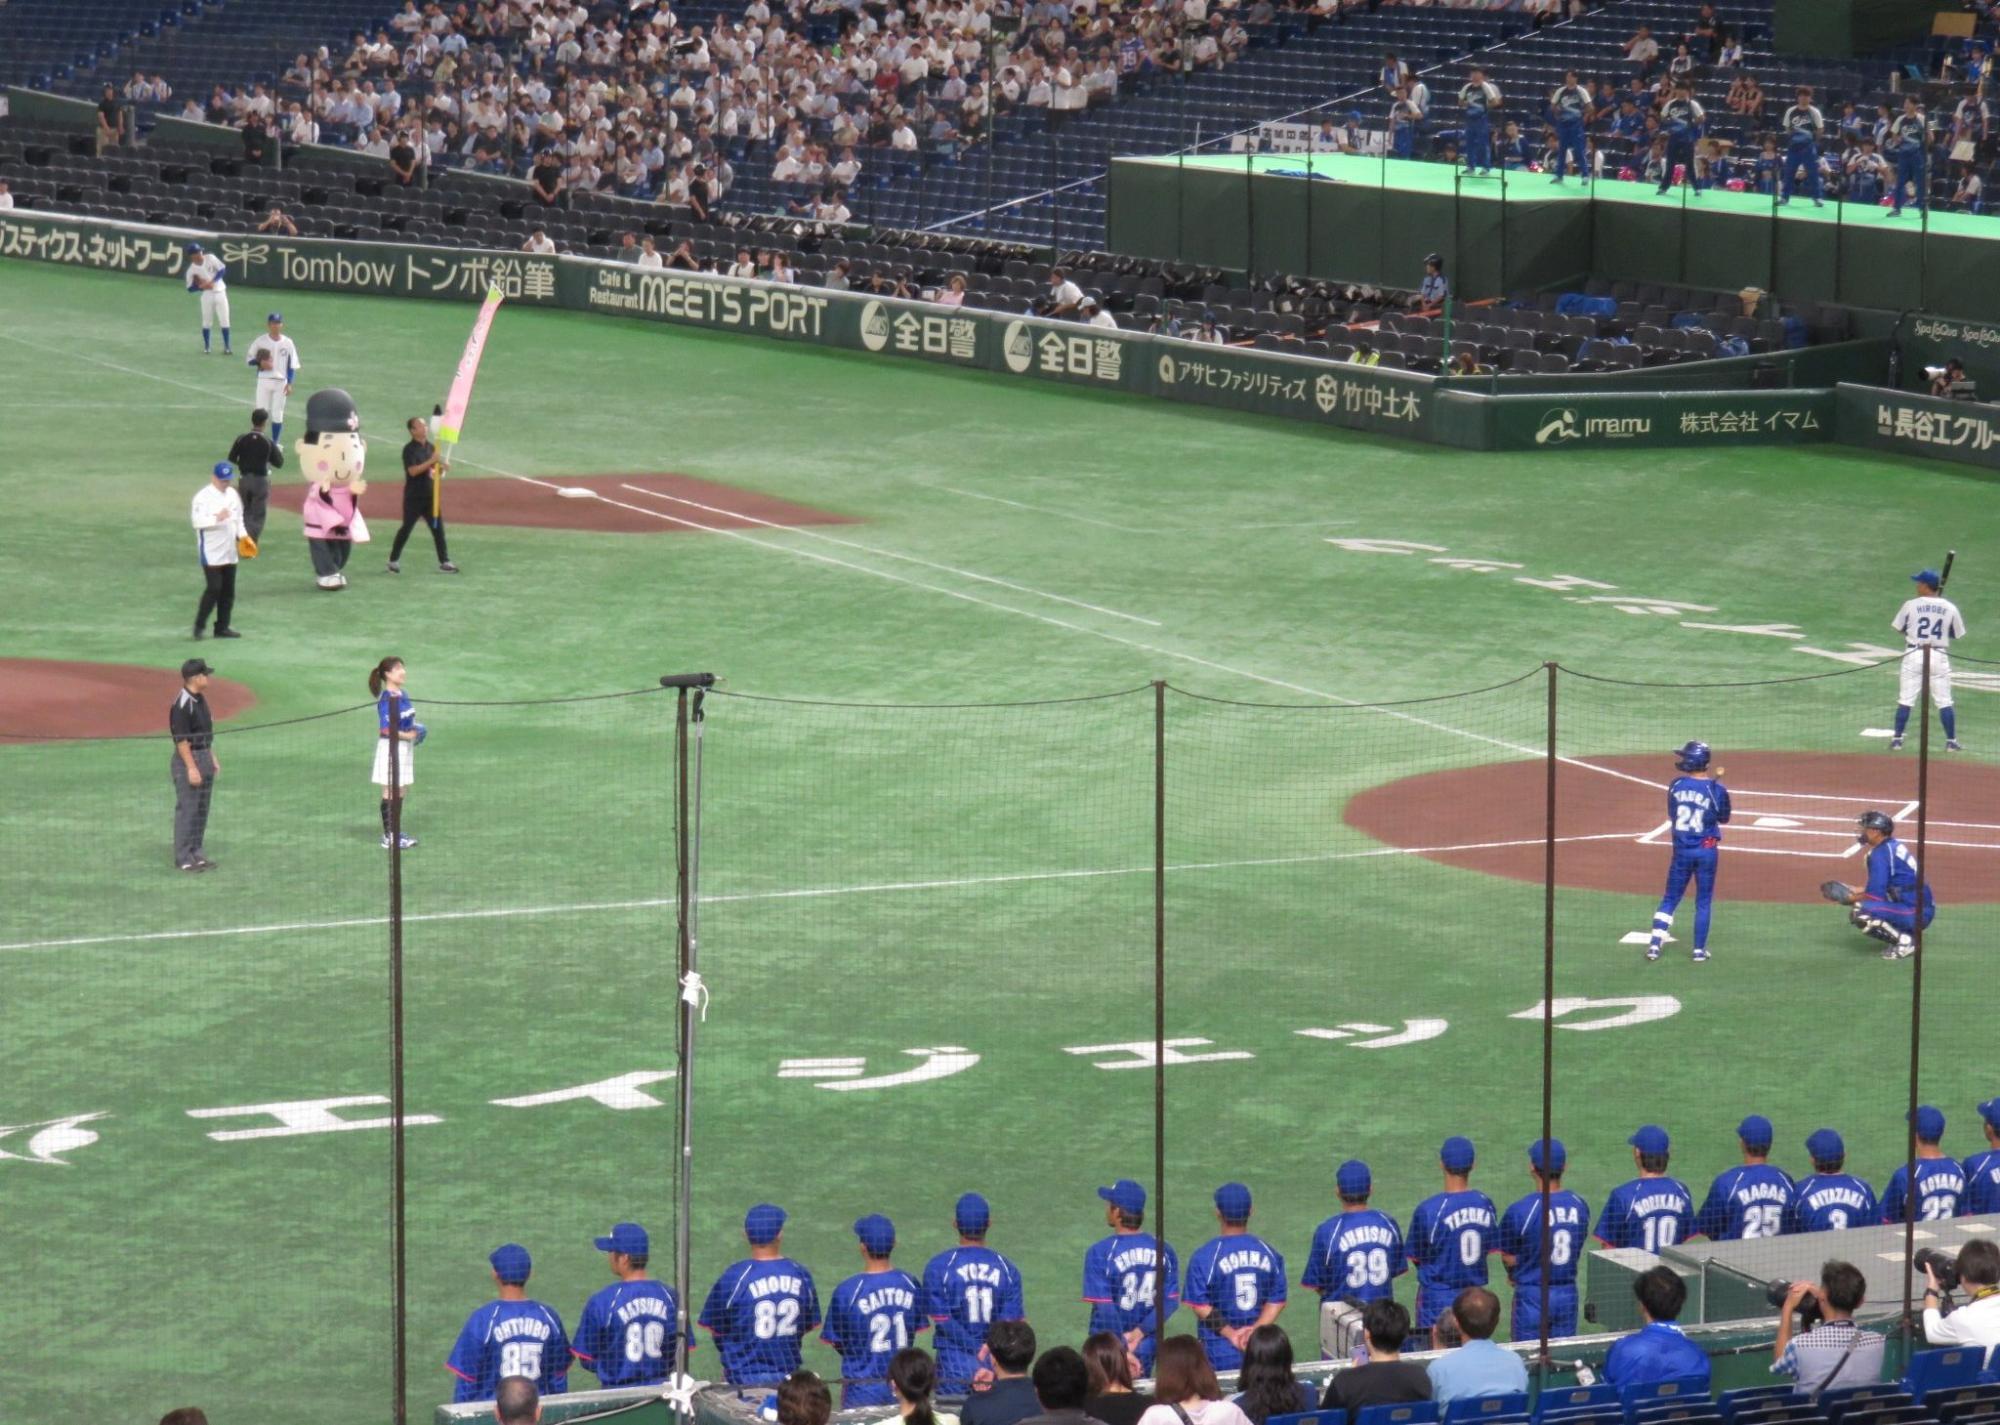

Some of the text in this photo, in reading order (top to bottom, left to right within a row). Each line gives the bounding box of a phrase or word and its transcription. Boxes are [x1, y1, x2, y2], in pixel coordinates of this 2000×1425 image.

[277, 248, 554, 299] Tombow トンボ鉛筆
[599, 270, 621, 287] Cafe
[590, 286, 638, 309] Restaurant
[640, 275, 827, 336] MEETS PORT
[894, 312, 976, 358] 全日警
[1039, 331, 1122, 380] 全日警
[1178, 361, 1307, 401] アサヒファシリティズ
[1342, 380, 1421, 421] 竹中土木
[1680, 411, 1820, 433] 株式会社 イマム
[1917, 616, 1943, 640] 24
[1675, 805, 1704, 833] 24
[1807, 1187, 1865, 1211] MIYAZAKI
[1443, 1206, 1491, 1232] TEZUKA
[1643, 1215, 1678, 1252] 10
[1742, 1204, 1783, 1240] 25
[1113, 1247, 1166, 1273] ENOMOT
[1460, 1229, 1481, 1266] 0
[1551, 1229, 1571, 1266] 8
[956, 1263, 1001, 1288] YOZA
[1346, 1248, 1389, 1288] 39
[749, 1275, 802, 1300] INOUE
[858, 1287, 914, 1315] SAITOH
[965, 1286, 993, 1324] 11
[1120, 1271, 1157, 1312] 34
[1235, 1272, 1258, 1311] 5
[754, 1299, 801, 1340] 82
[870, 1311, 908, 1352] 21
[625, 1320, 665, 1363] 80
[500, 1341, 544, 1381] 85
